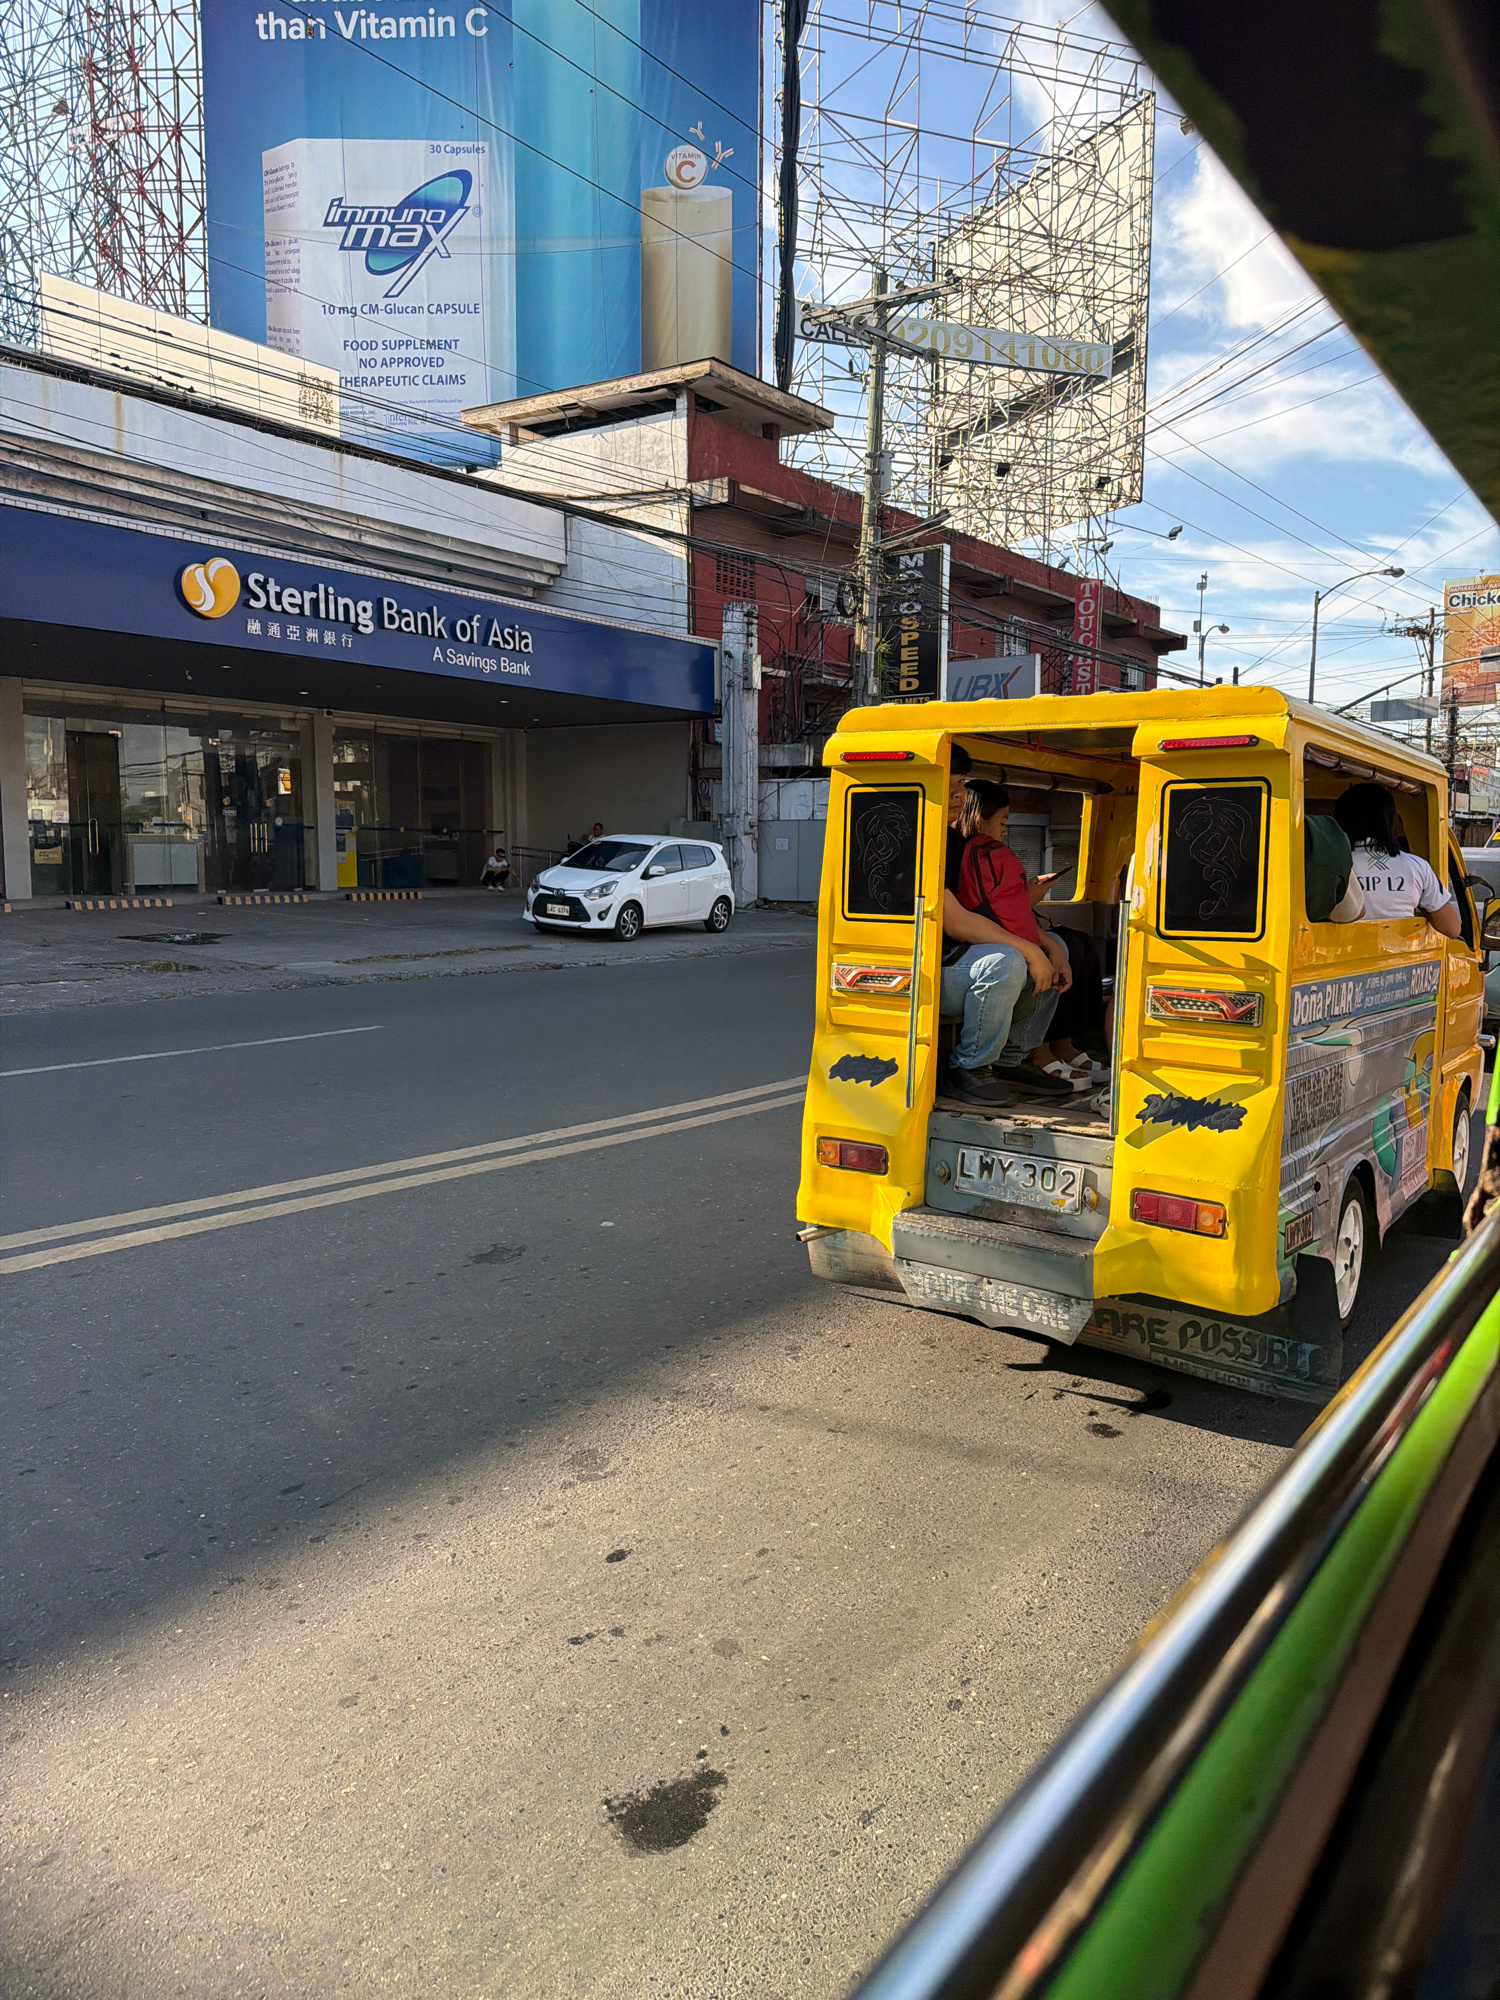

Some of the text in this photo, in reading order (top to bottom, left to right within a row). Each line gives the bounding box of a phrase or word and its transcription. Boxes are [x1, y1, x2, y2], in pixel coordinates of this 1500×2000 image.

[255, 7, 489, 40] than Vitamin C
[429, 144, 486, 156] 30 Capsules
[675, 160, 697, 183] C
[325, 199, 448, 225] immuno
[341, 206, 471, 298] max
[321, 303, 480, 318] 10 mg CM-Glucan CAPSULE
[343, 339, 459, 351] FOOD SUPPLEMENT
[359, 357, 445, 369] NO APPROVED
[340, 374, 466, 388] THERAPEUTIC CLAIMS
[247, 572, 534, 654] Sterling Bank of Asia
[432, 646, 532, 676] A Savings Bank
[899, 616, 920, 692] SPEED
[1292, 985, 1323, 1028] Doña
[1323, 981, 1354, 1018] PILAR
[1410, 965, 1433, 997] ROXAS
[1094, 1308, 1169, 1347] ARE
